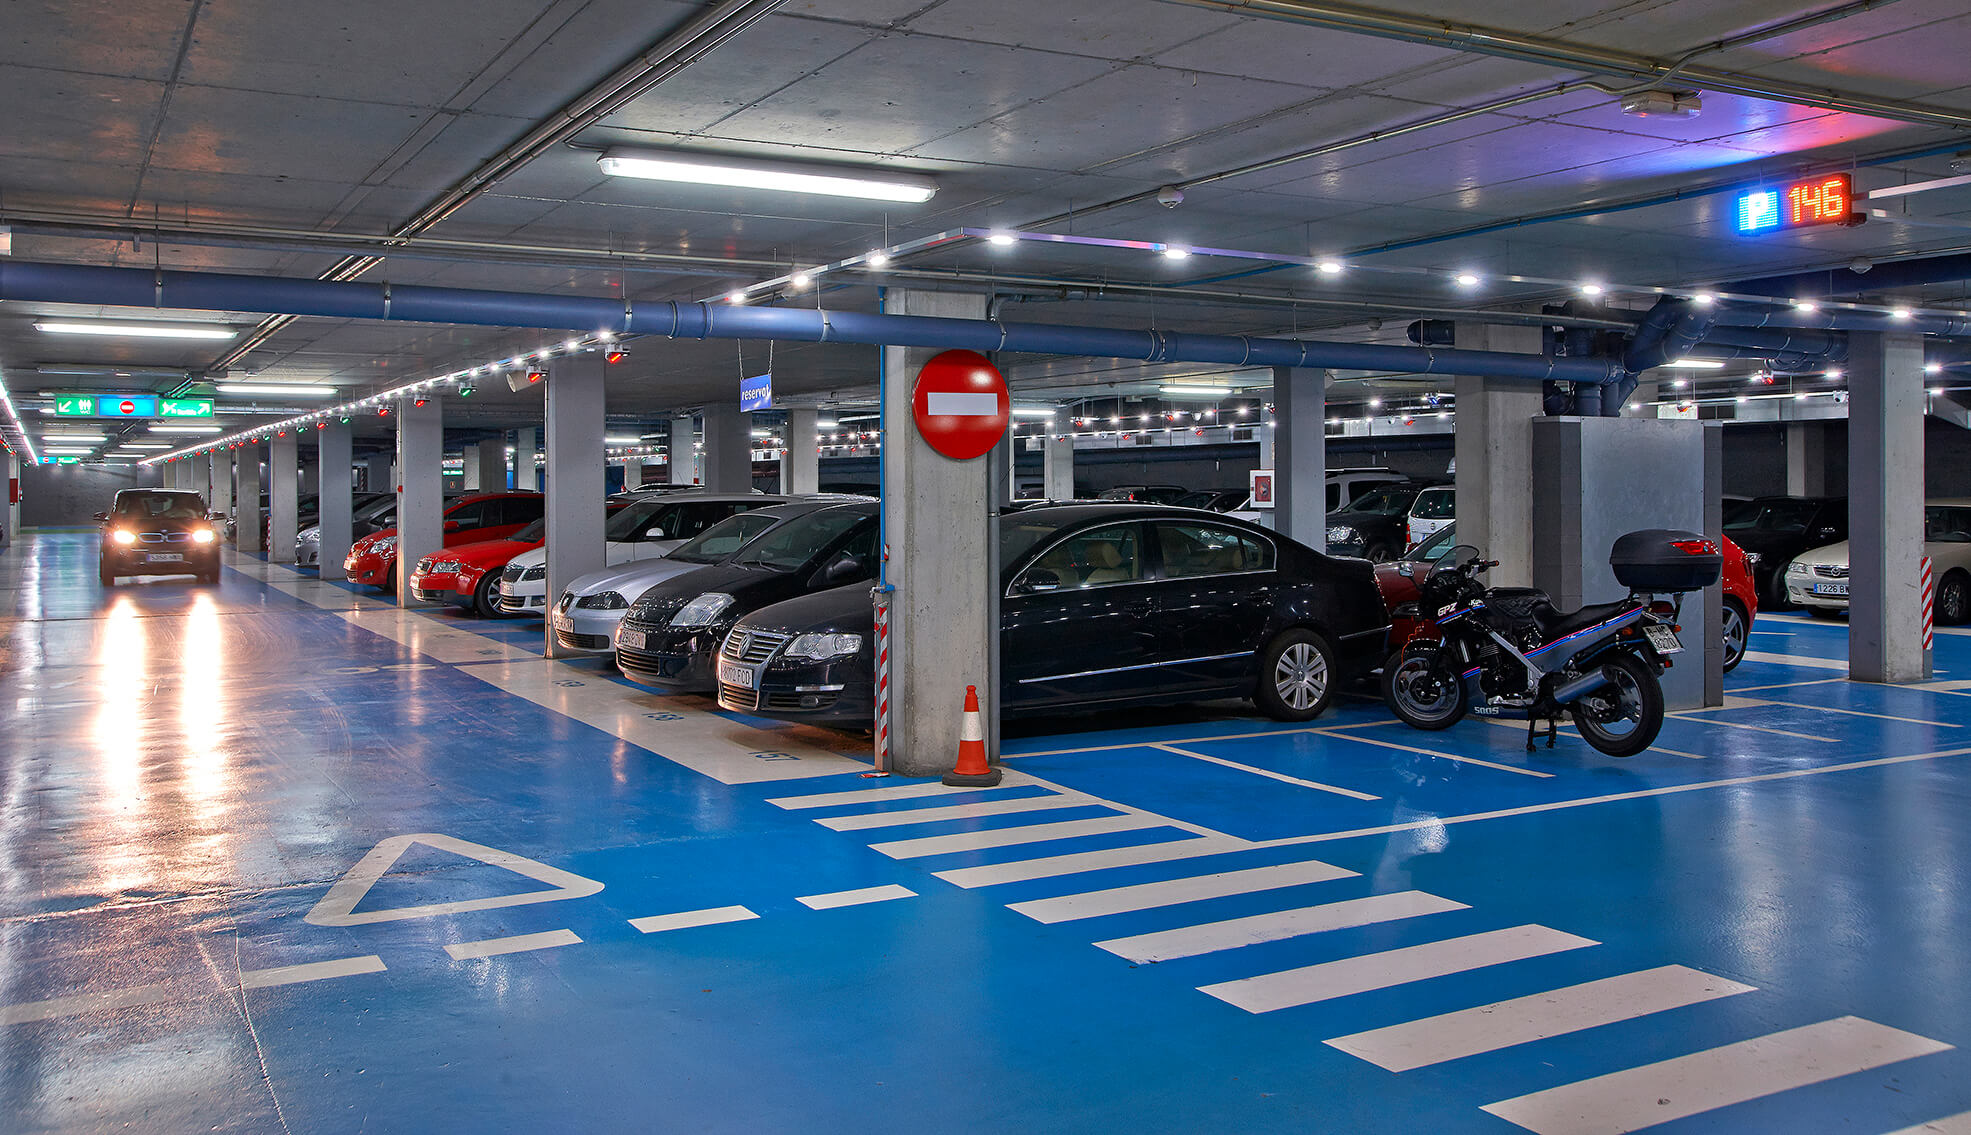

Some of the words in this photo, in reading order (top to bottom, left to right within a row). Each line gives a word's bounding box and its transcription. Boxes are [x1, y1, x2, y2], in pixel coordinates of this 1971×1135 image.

[1747, 193, 1769, 229] P
[1788, 180, 1842, 222] 146
[1818, 584, 1838, 593] 1226
[1437, 601, 1458, 617] GPZ
[748, 750, 802, 762] 157
